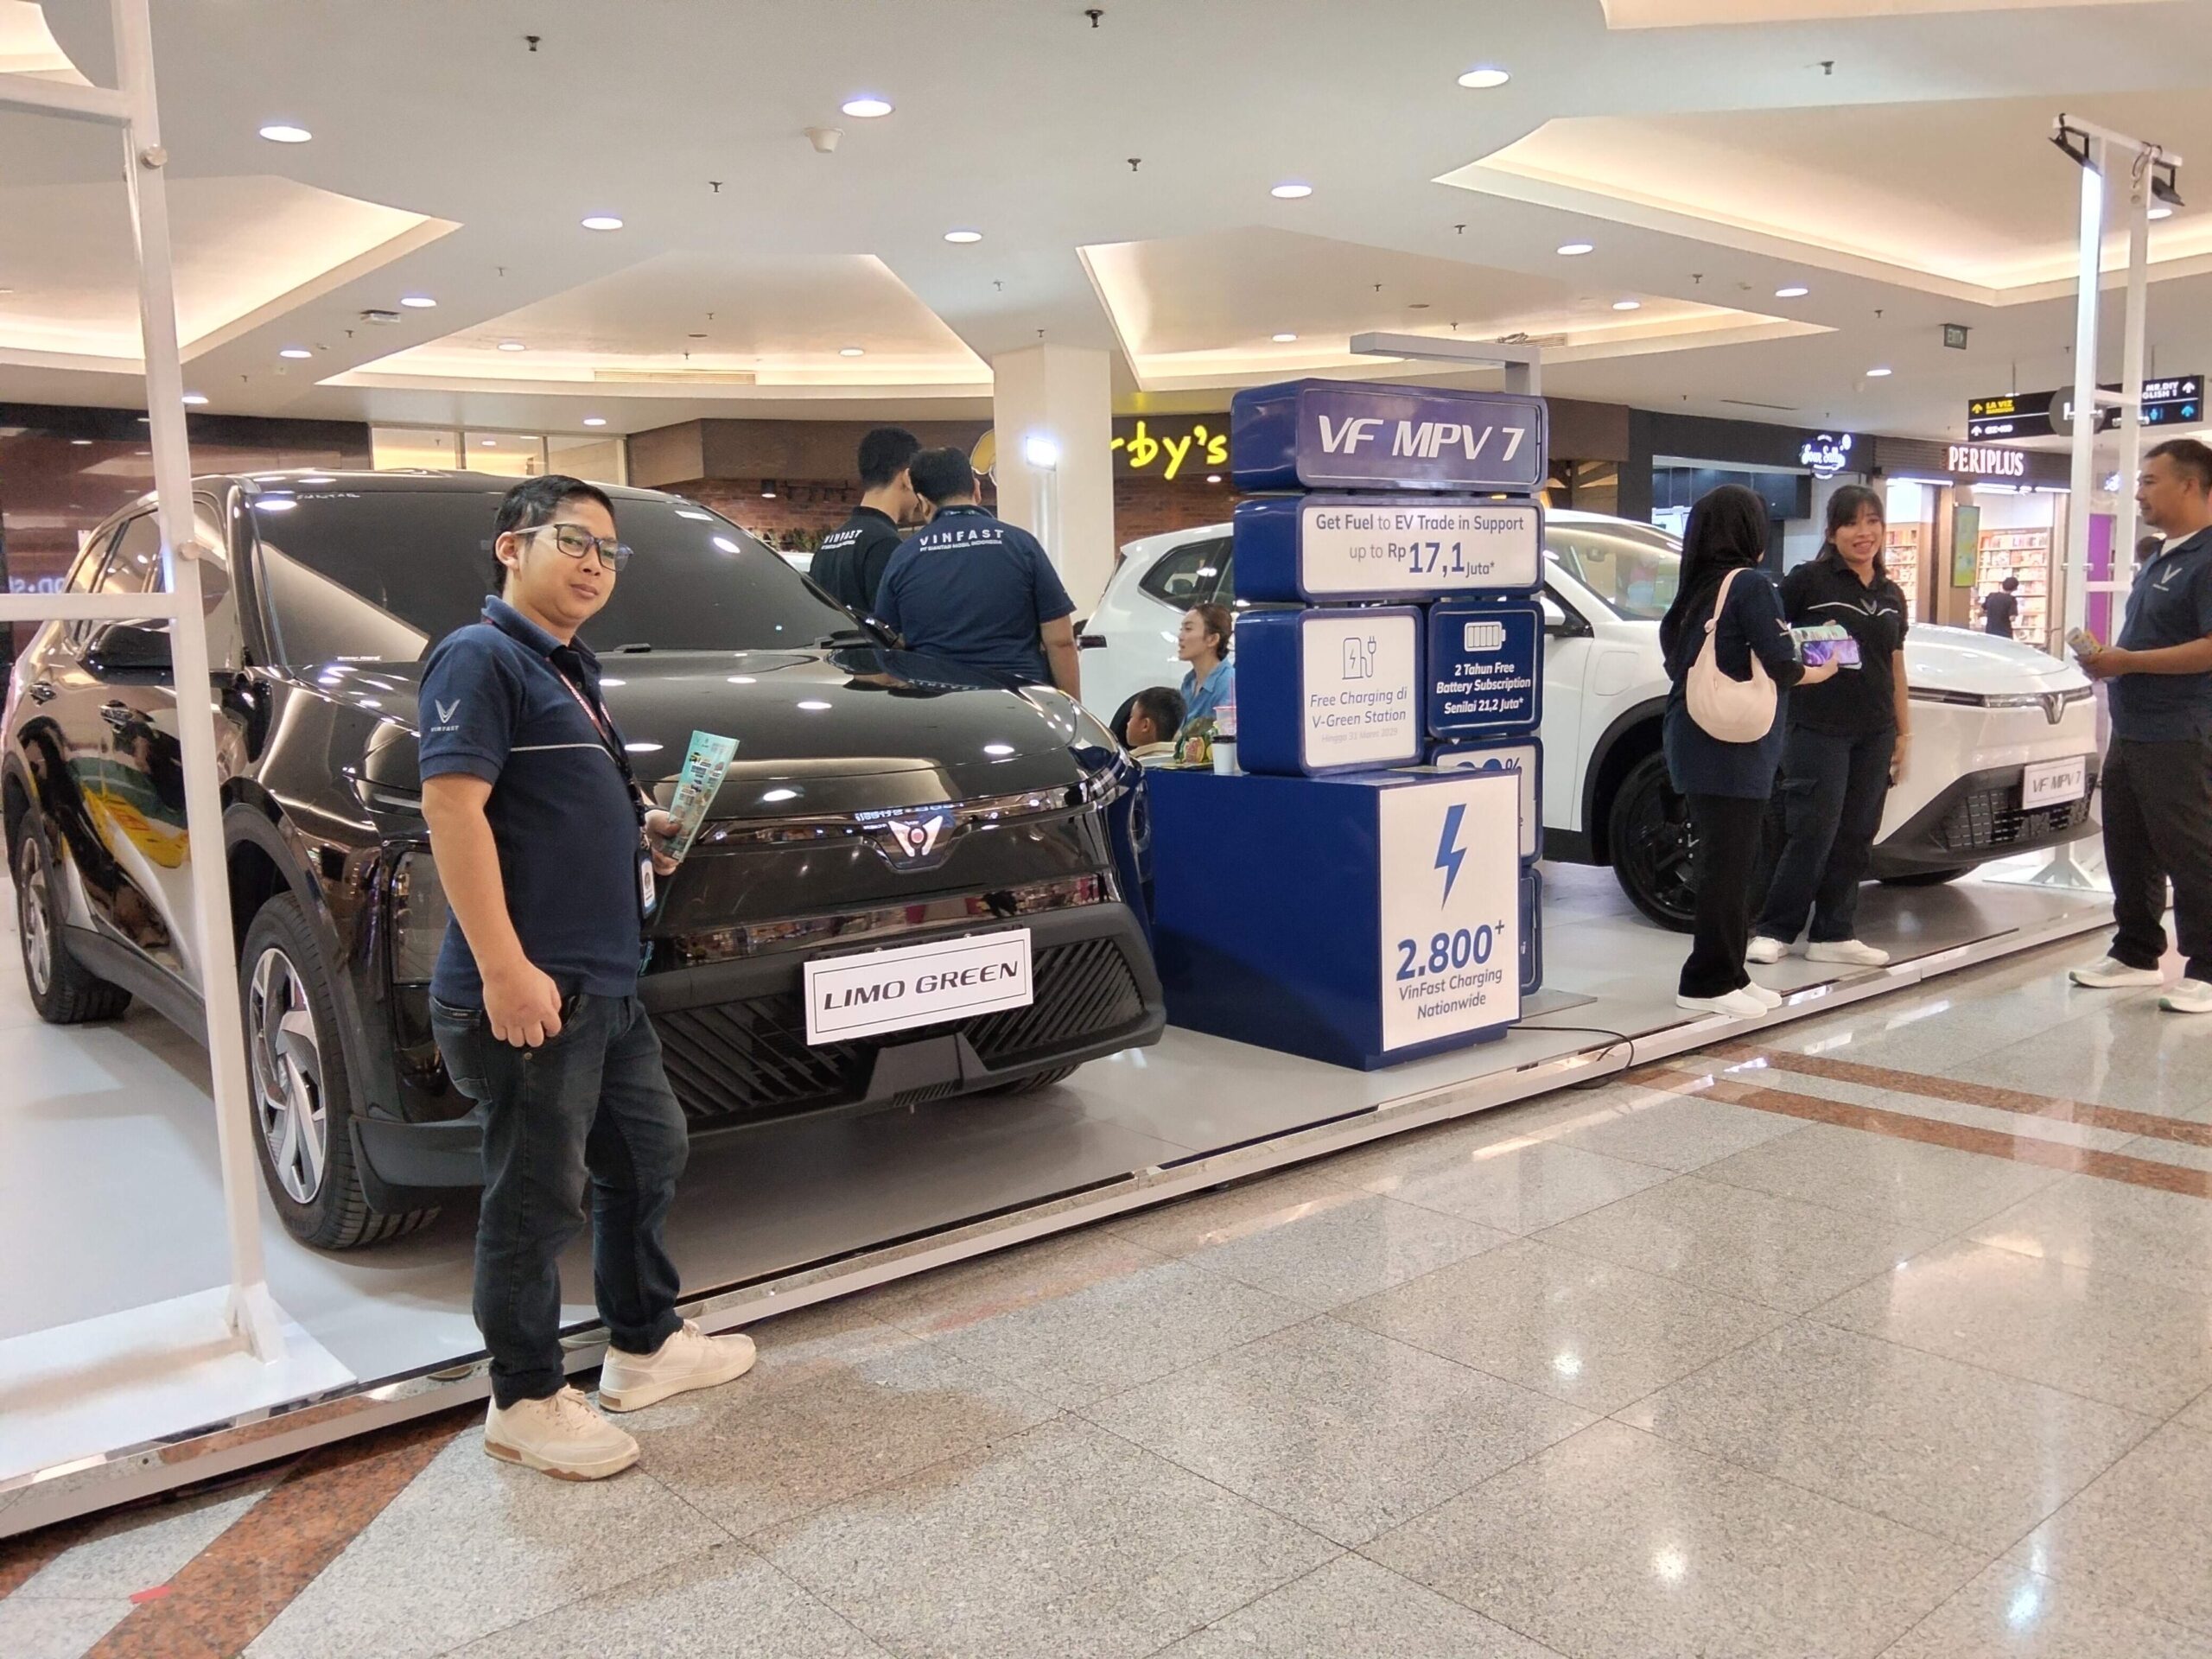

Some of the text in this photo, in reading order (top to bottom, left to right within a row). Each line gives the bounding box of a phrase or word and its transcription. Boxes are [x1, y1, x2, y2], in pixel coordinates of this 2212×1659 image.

[1986, 401, 1997, 410] LA
[1319, 415, 1525, 461] VF MPV 7
[1948, 446, 2024, 476] PERIPLUS
[1316, 514, 1524, 534] Get Fuel to EV Trade in Support
[919, 529, 1004, 546] VINFAST
[1350, 546, 1367, 562] up
[1370, 544, 1383, 558] to
[1454, 662, 1515, 676] 2 Tahun Free
[1436, 677, 1531, 695] Battery Subscription
[1311, 686, 1408, 707] Free Charging di
[1444, 700, 1477, 715] Senilai
[1478, 699, 1499, 712] 21,2
[1312, 708, 1407, 728] V-Green Station
[1349, 732, 1357, 741] 31
[2033, 770, 2082, 792] VF MPV 7
[823, 961, 1019, 1010] LIMO GREEN
[1399, 969, 1503, 1001] VinFast Charging
[1417, 992, 1486, 1020] Nationwide
